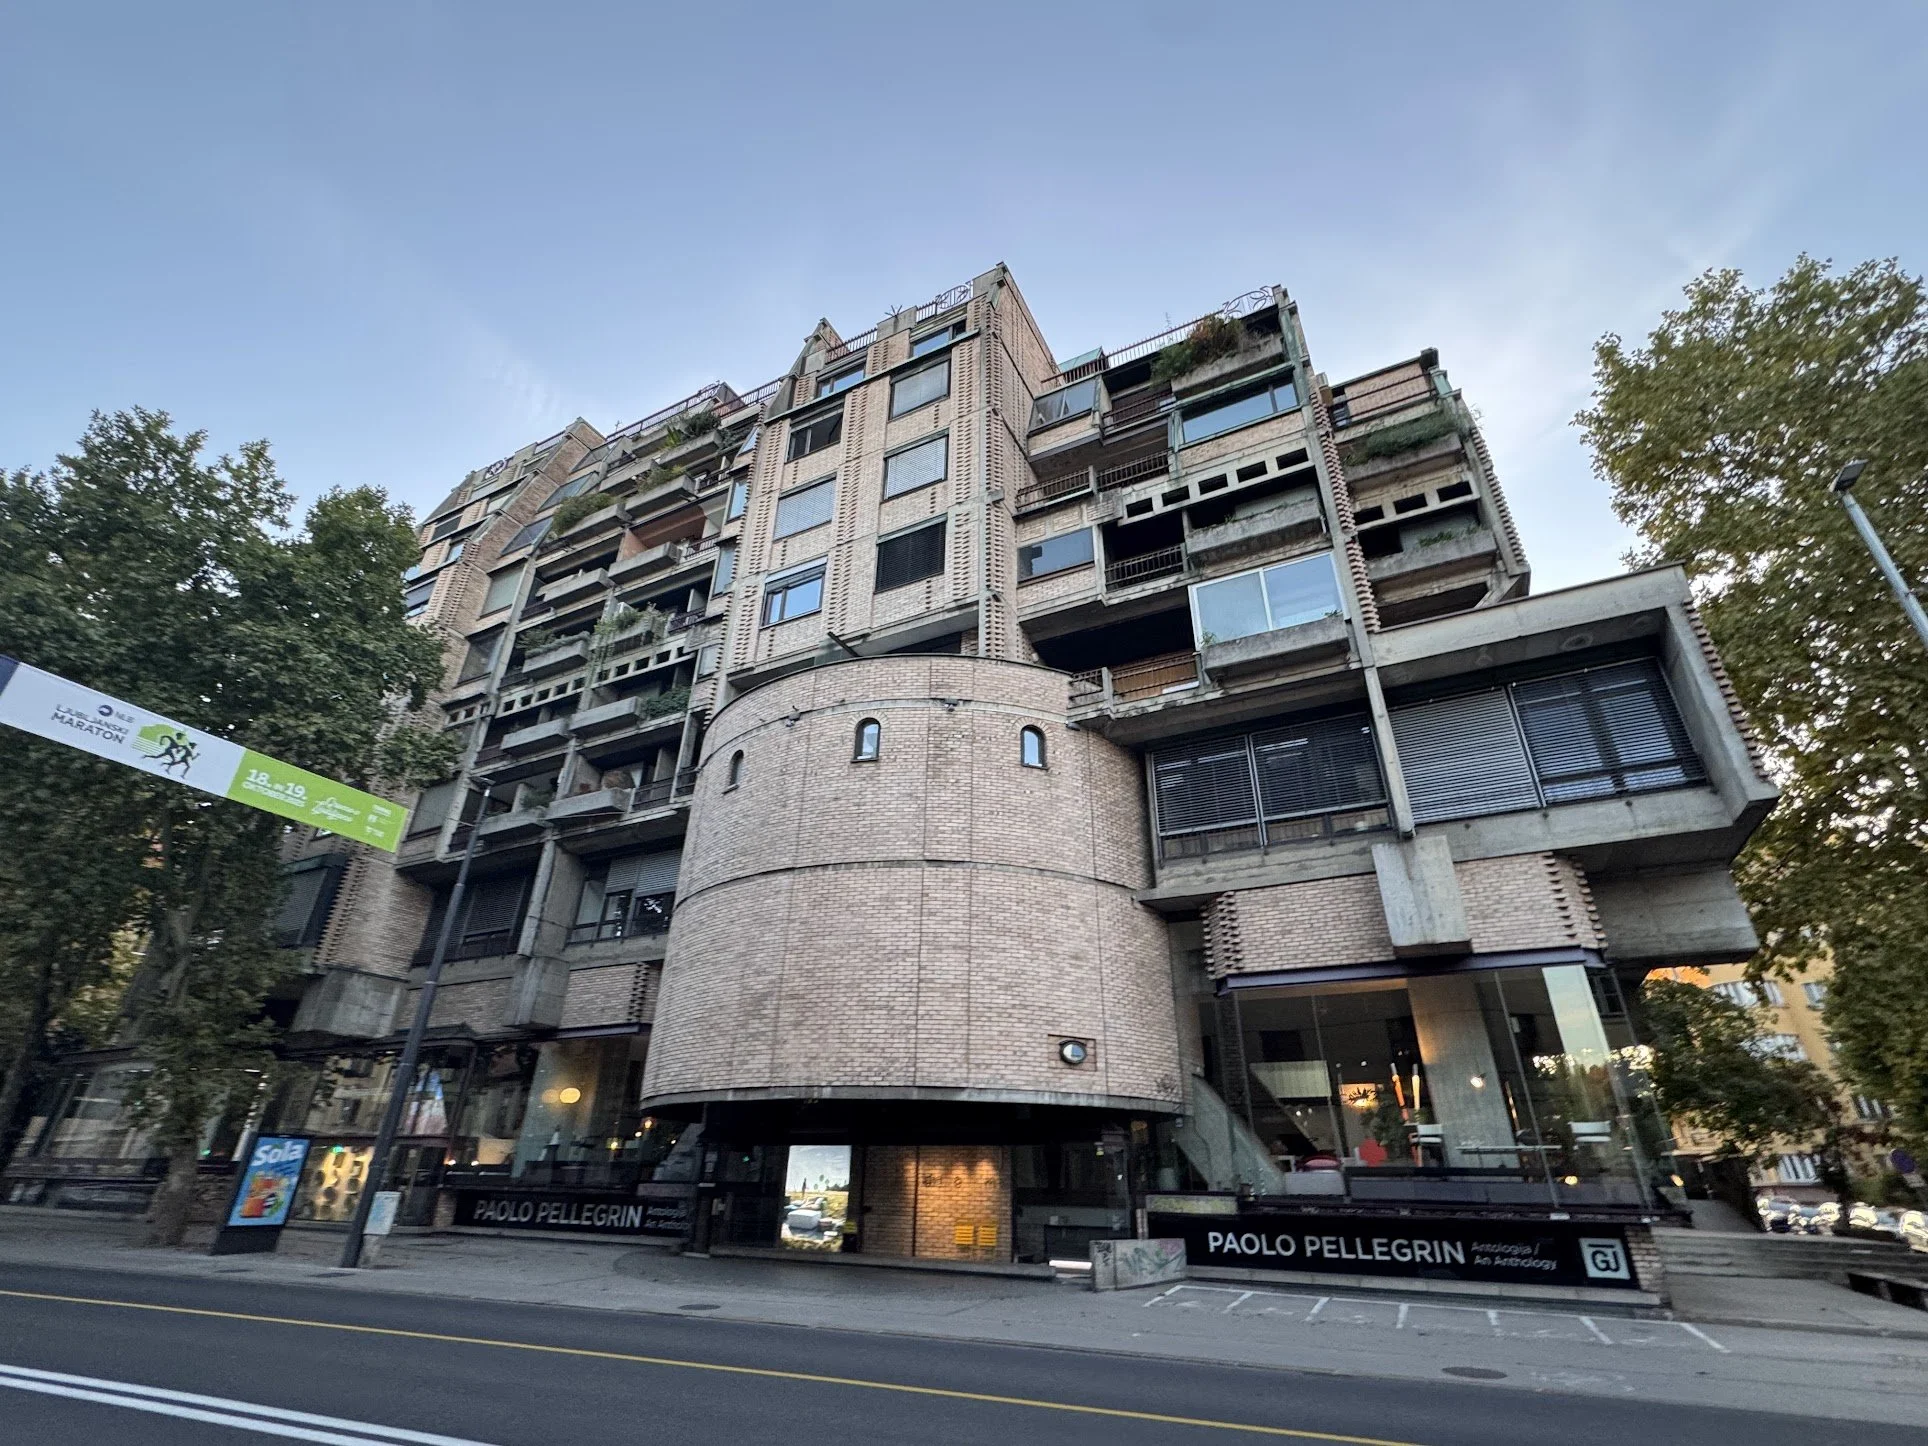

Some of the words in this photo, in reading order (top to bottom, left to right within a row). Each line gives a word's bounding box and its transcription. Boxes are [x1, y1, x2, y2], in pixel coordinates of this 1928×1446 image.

[51, 711, 126, 744] MARATON
[246, 769, 272, 787] 18.
[284, 782, 308, 800] 19.
[251, 1140, 305, 1167] Sola
[473, 1199, 533, 1222] PAOLO
[535, 1202, 643, 1229] PELLEGRIN
[1208, 1231, 1296, 1256] PAOLO
[1303, 1235, 1466, 1265] PELLEGRIN
[1474, 1255, 1491, 1265] An
[1494, 1255, 1557, 1270] Anthology
